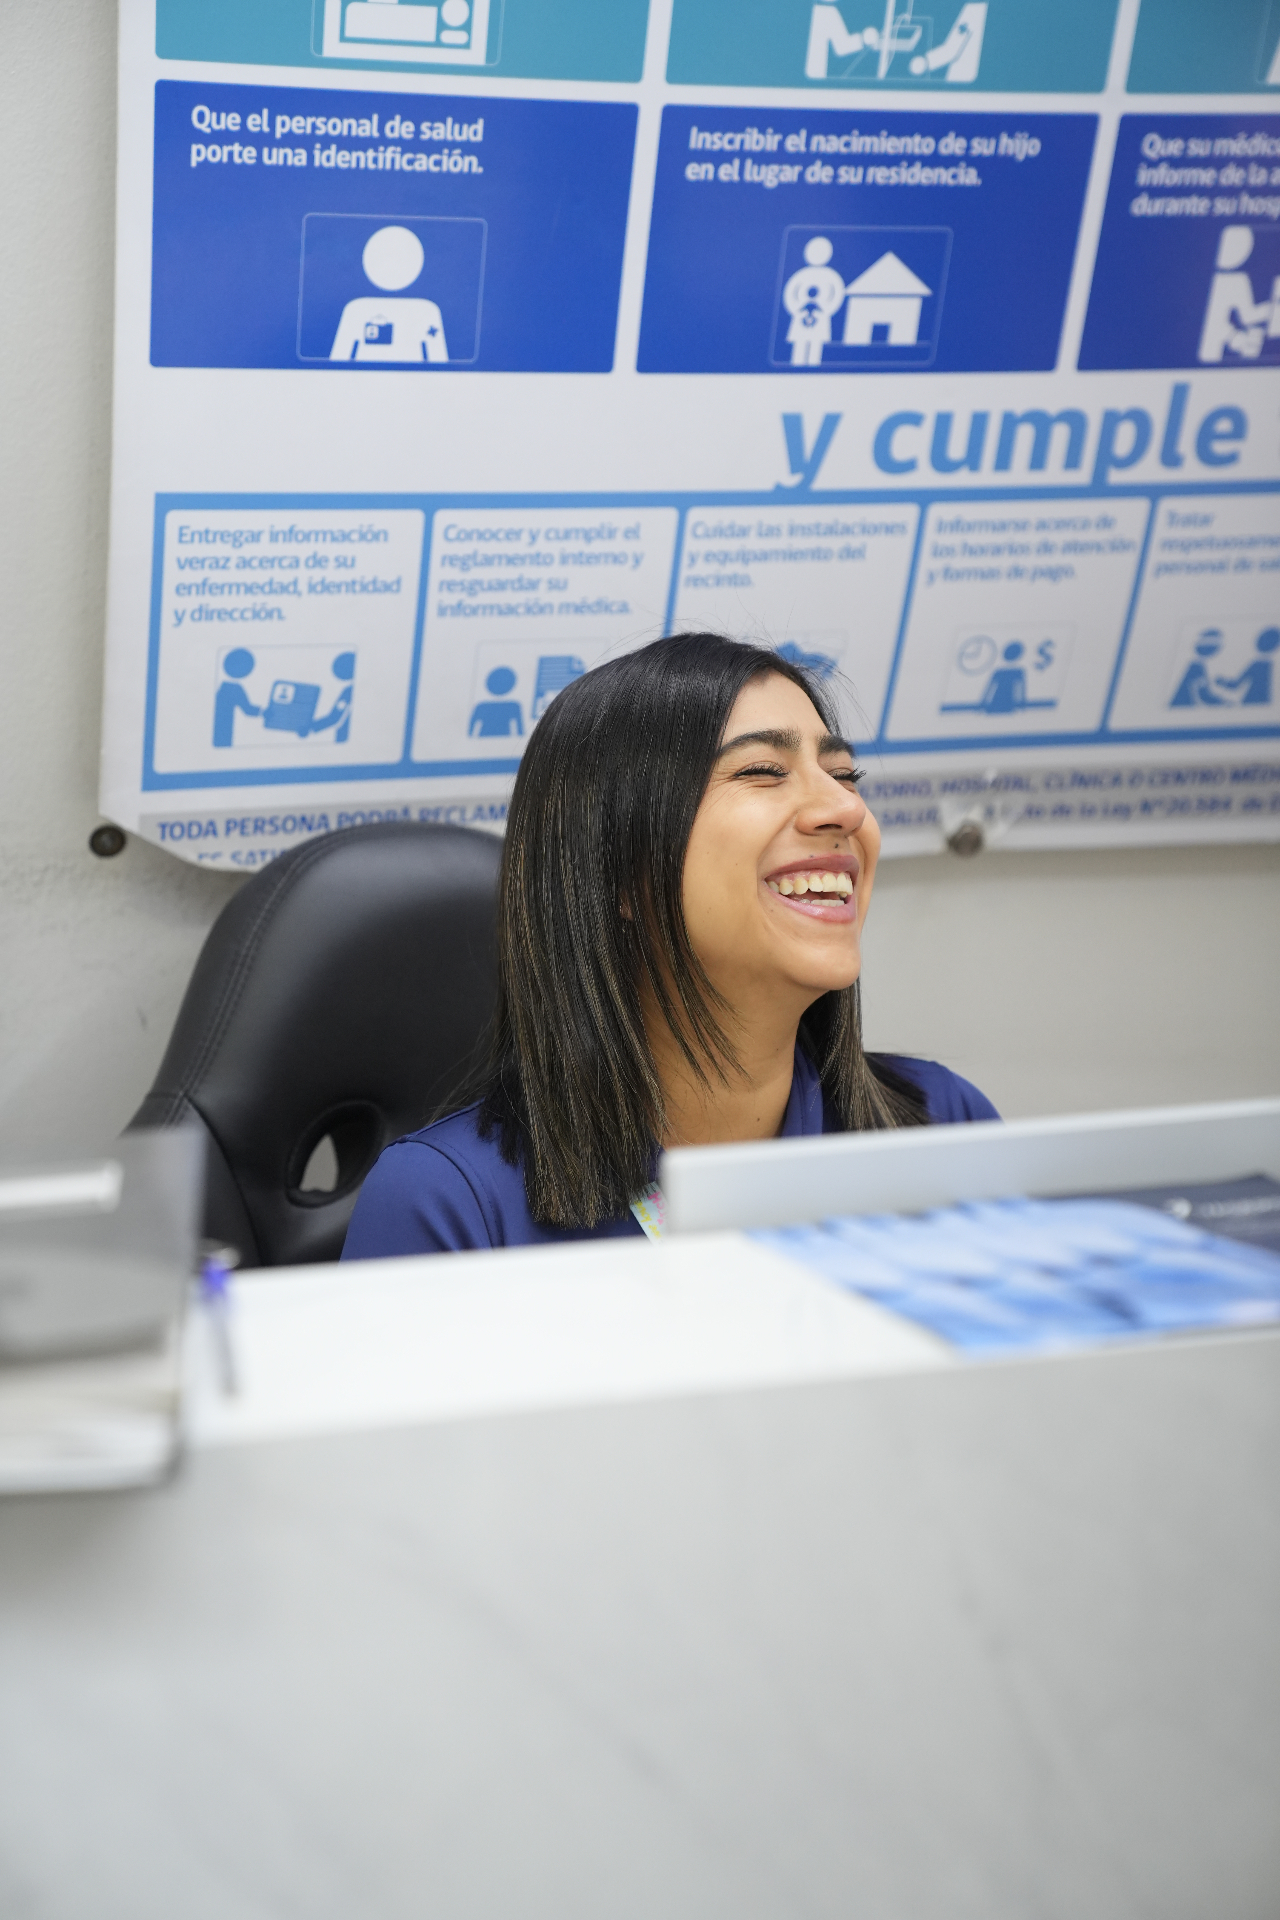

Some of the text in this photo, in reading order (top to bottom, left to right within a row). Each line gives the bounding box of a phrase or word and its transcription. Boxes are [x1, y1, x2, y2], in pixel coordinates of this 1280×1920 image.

[191, 104, 485, 142] Que el personal de salud
[689, 125, 1042, 162] Inscribir el nacimiento de su hijo
[1142, 131, 1185, 160] Que
[1187, 137, 1212, 157] su
[190, 142, 484, 173] porte una identificación.
[685, 157, 982, 188] en el lugar de su residencia.
[1136, 162, 1217, 187] informe
[1219, 162, 1246, 187] de
[1248, 162, 1268, 187] la
[1129, 192, 1211, 216] durante
[1213, 196, 1238, 216] su
[773, 382, 1248, 491] y cumple
[178, 524, 388, 548] Entregar información
[443, 523, 641, 545] Conocer y cumplir el
[176, 551, 356, 570] veraz acerca de su
[441, 548, 645, 571] reglamento interno y
[175, 575, 402, 597] enfermedad, identidad
[438, 574, 569, 597] resguardar su
[172, 602, 286, 627] y dirección.
[437, 597, 632, 618] información médica.
[157, 819, 218, 842] TODA
[225, 812, 330, 838] PERSONA
